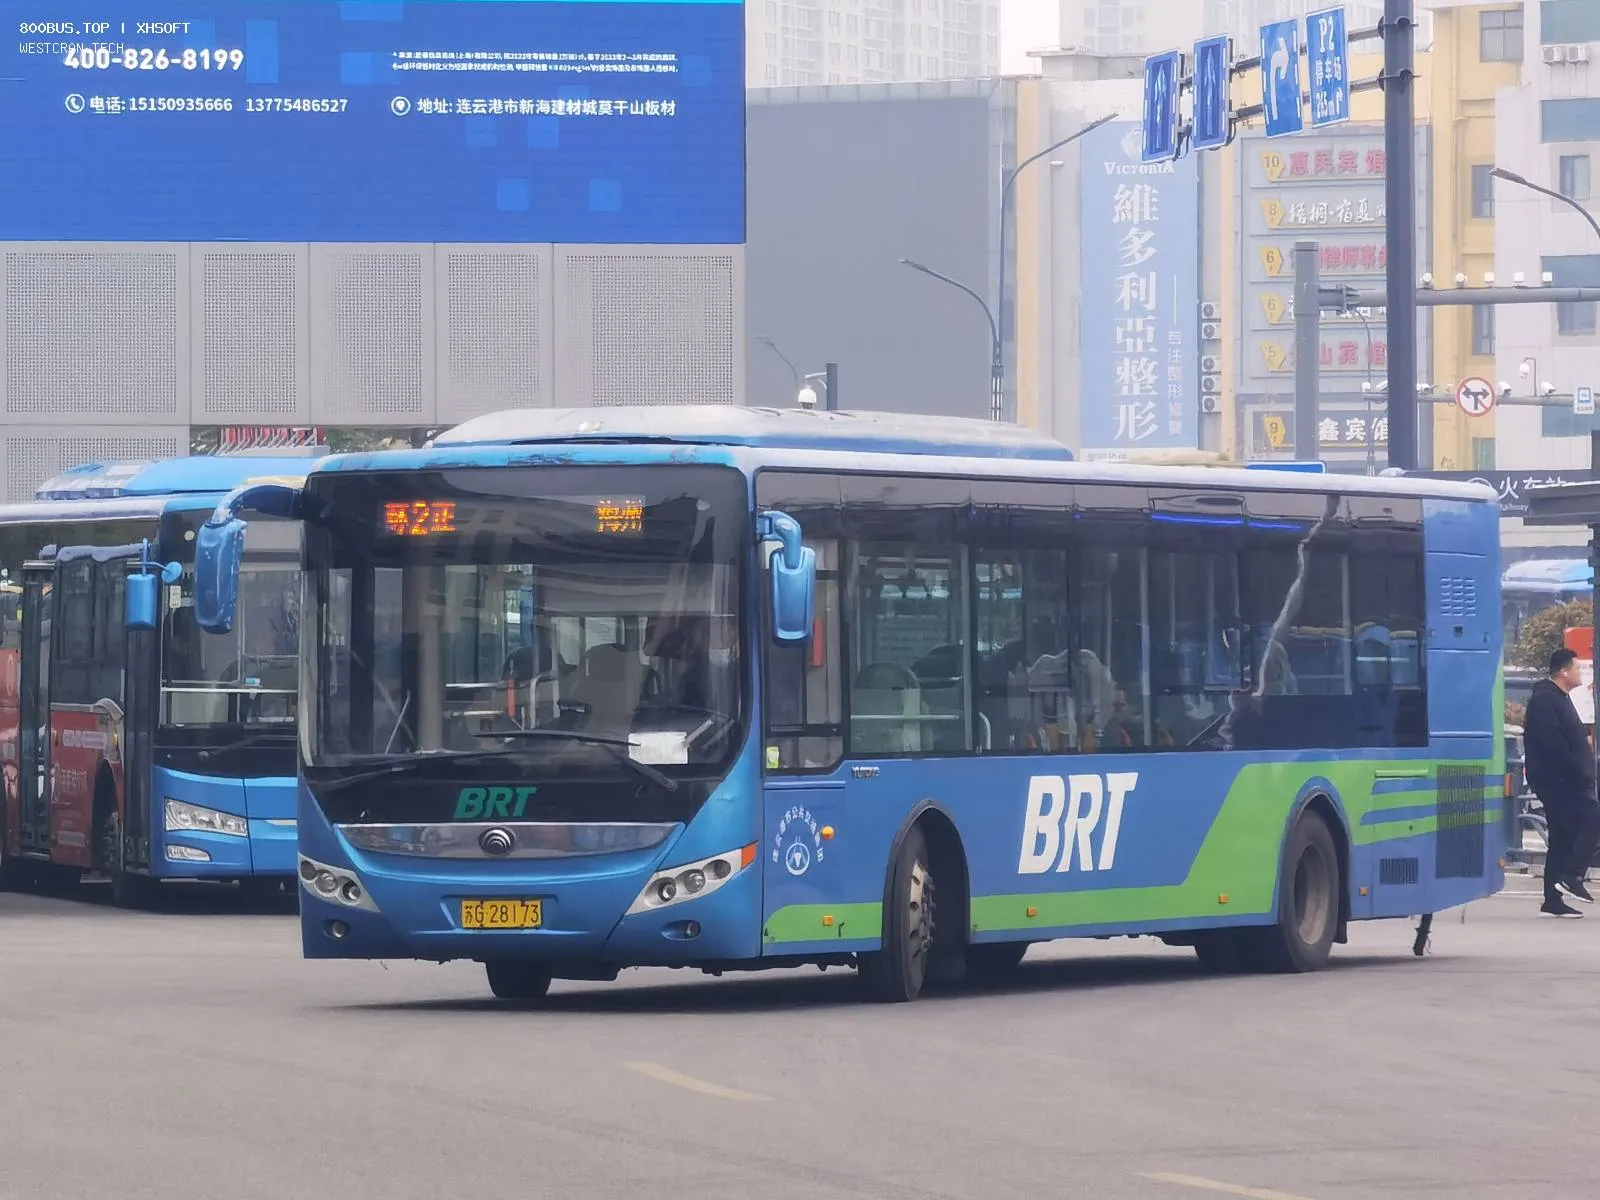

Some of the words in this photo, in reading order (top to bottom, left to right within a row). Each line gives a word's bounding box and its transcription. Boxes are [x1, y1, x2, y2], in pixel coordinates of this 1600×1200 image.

[1319, 15, 1335, 52] P2
[63, 47, 244, 70] 400-826-8199
[129, 97, 233, 112] 15150935666
[245, 98, 348, 113] 13775486527
[1264, 155, 1280, 168] 10
[454, 786, 538, 820] BRT
[1018, 772, 1139, 875] BRT
